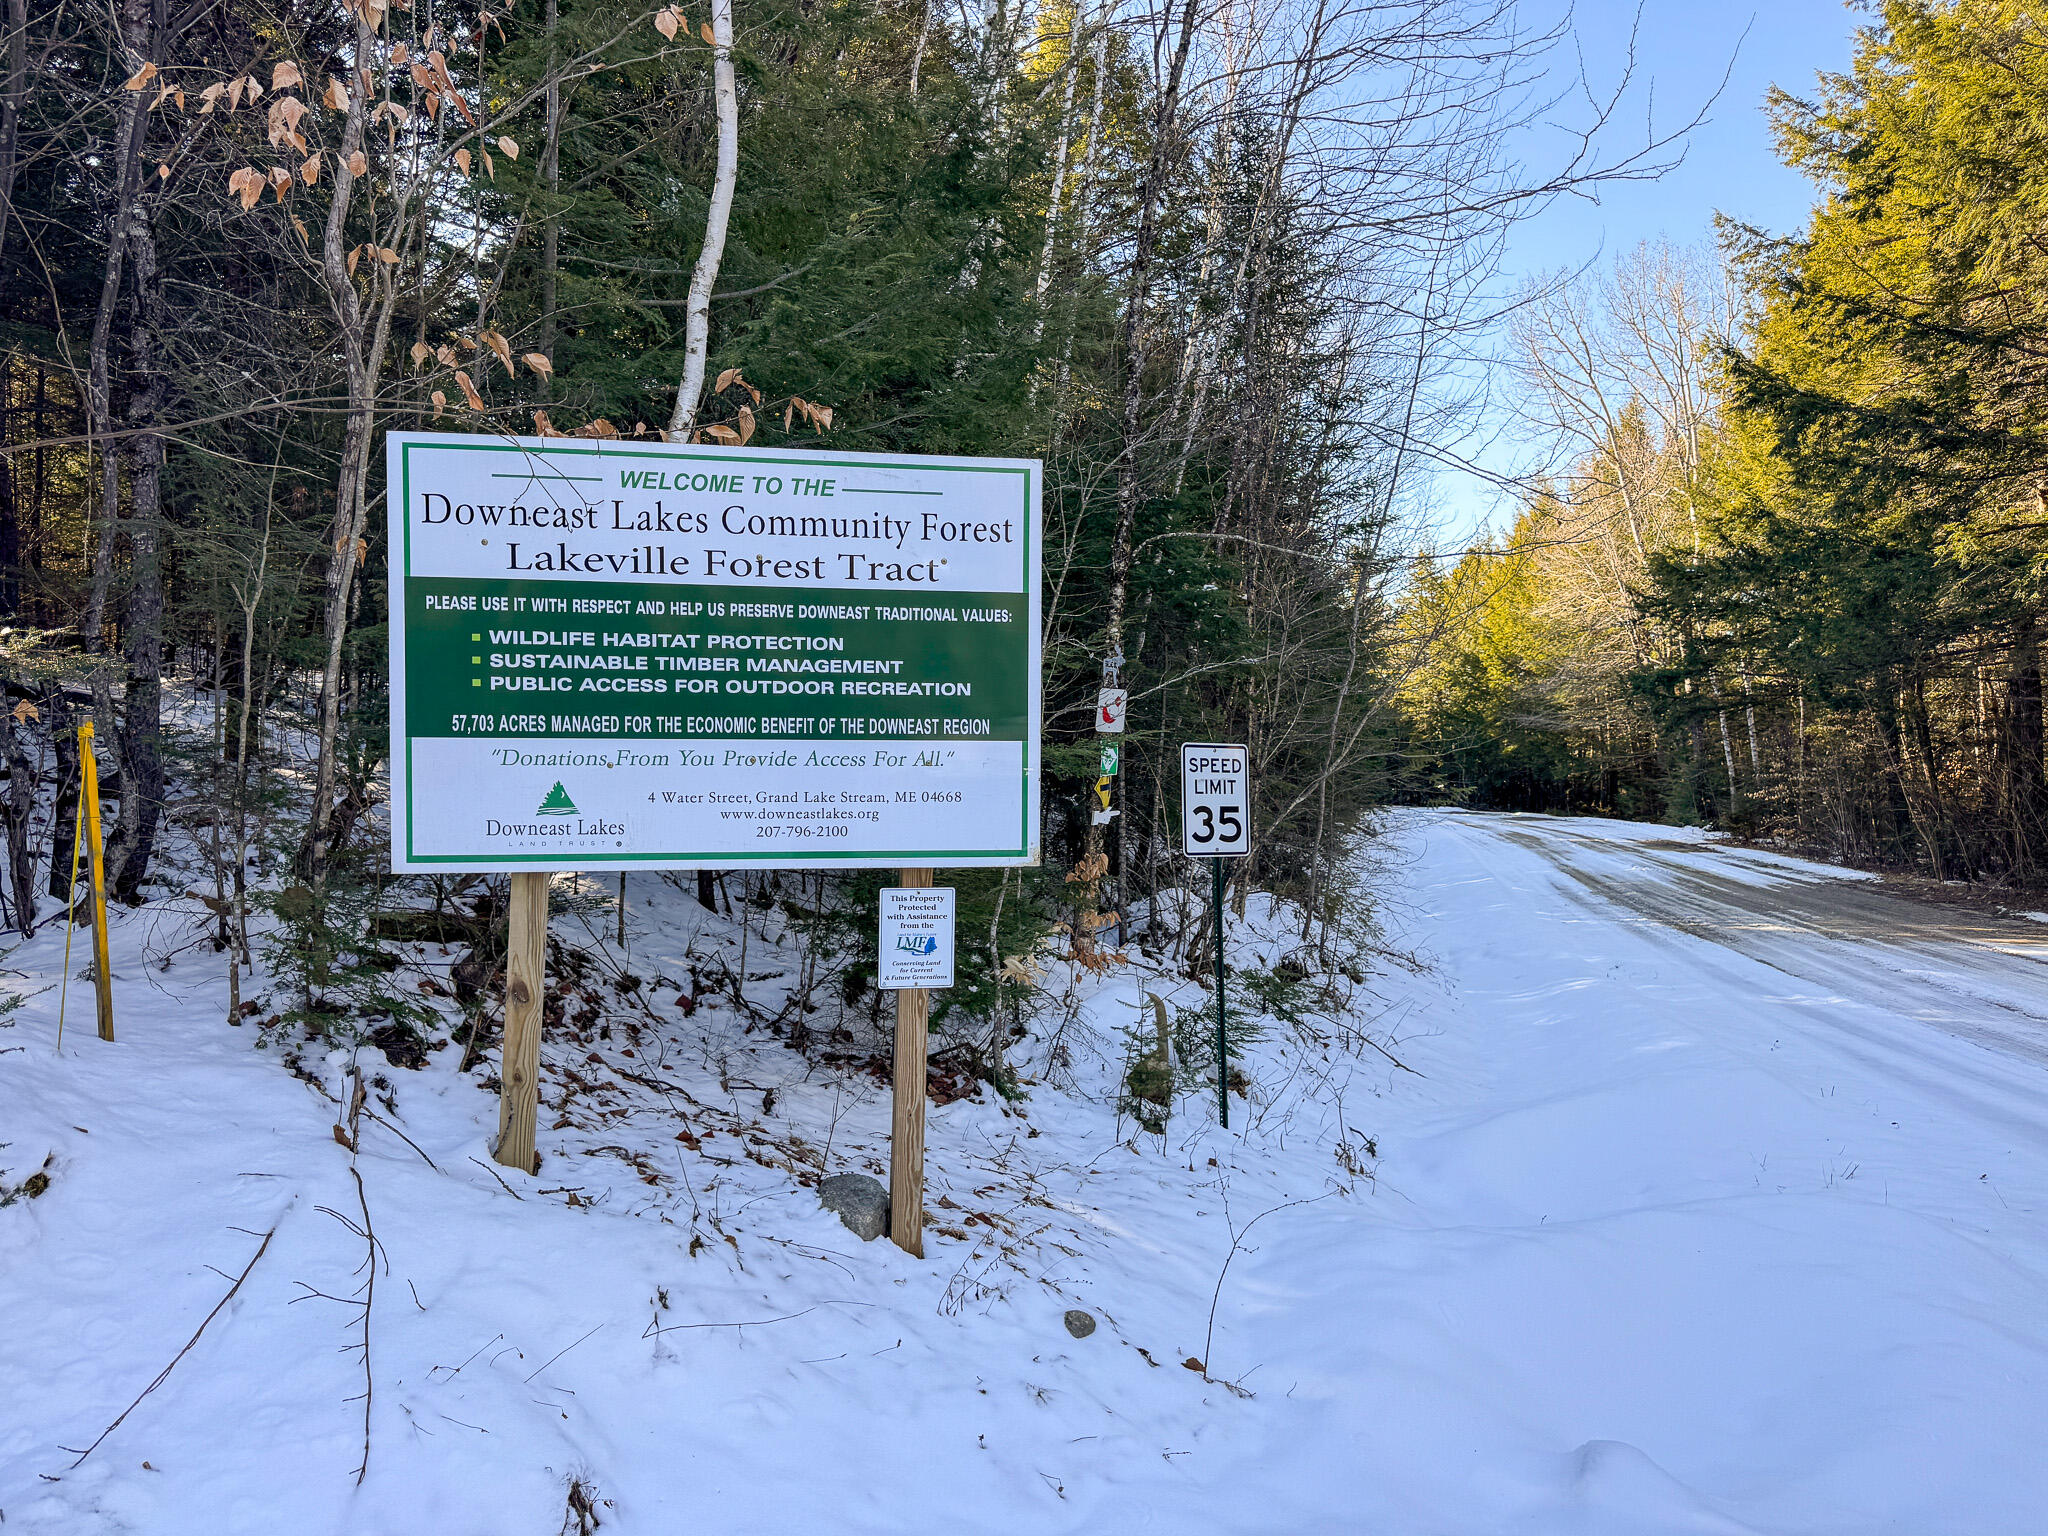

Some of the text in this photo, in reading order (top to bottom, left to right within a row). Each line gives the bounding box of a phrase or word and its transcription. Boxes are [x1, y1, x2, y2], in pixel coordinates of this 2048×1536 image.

[621, 470, 836, 497] WELCOME TO THE
[422, 493, 1013, 549] Downeast Lakes Community Forest
[507, 543, 939, 582] Lakeville Forest Tract
[426, 595, 1012, 623] PLEASE USE IT WITH RESPECT AND HELP US PRESERVE DOWNEAST TRADITIONAL VALUES:
[489, 630, 844, 651] WILDLIFE HABITAT PROTECTION
[489, 654, 903, 674] SUSTAINABLE TIMBER MANAGEMENT
[490, 676, 971, 696] PUBLIC ACCESS FOR OUTDOOR RECREATION
[452, 714, 990, 735] 57,703 ACRES MANAGED FOR THE ECONOMIC BENEFIT OF THE DOWNEAST REGION
[615, 750, 669, 767] From
[679, 750, 714, 766] You
[723, 750, 797, 767] Provide
[805, 751, 866, 767] Access
[873, 751, 906, 767] For
[1189, 758, 1241, 773] SPEED
[1195, 780, 1236, 795] LIMIT
[648, 791, 962, 805] 4 Water Street, Grand Lake Stream, ME 04668
[720, 807, 879, 822] www.downeastlakes.org
[1192, 806, 1241, 843] 35
[486, 819, 625, 836] Downeast Lakes
[756, 826, 848, 838] 207-796-2100
[910, 895, 944, 903] Property
